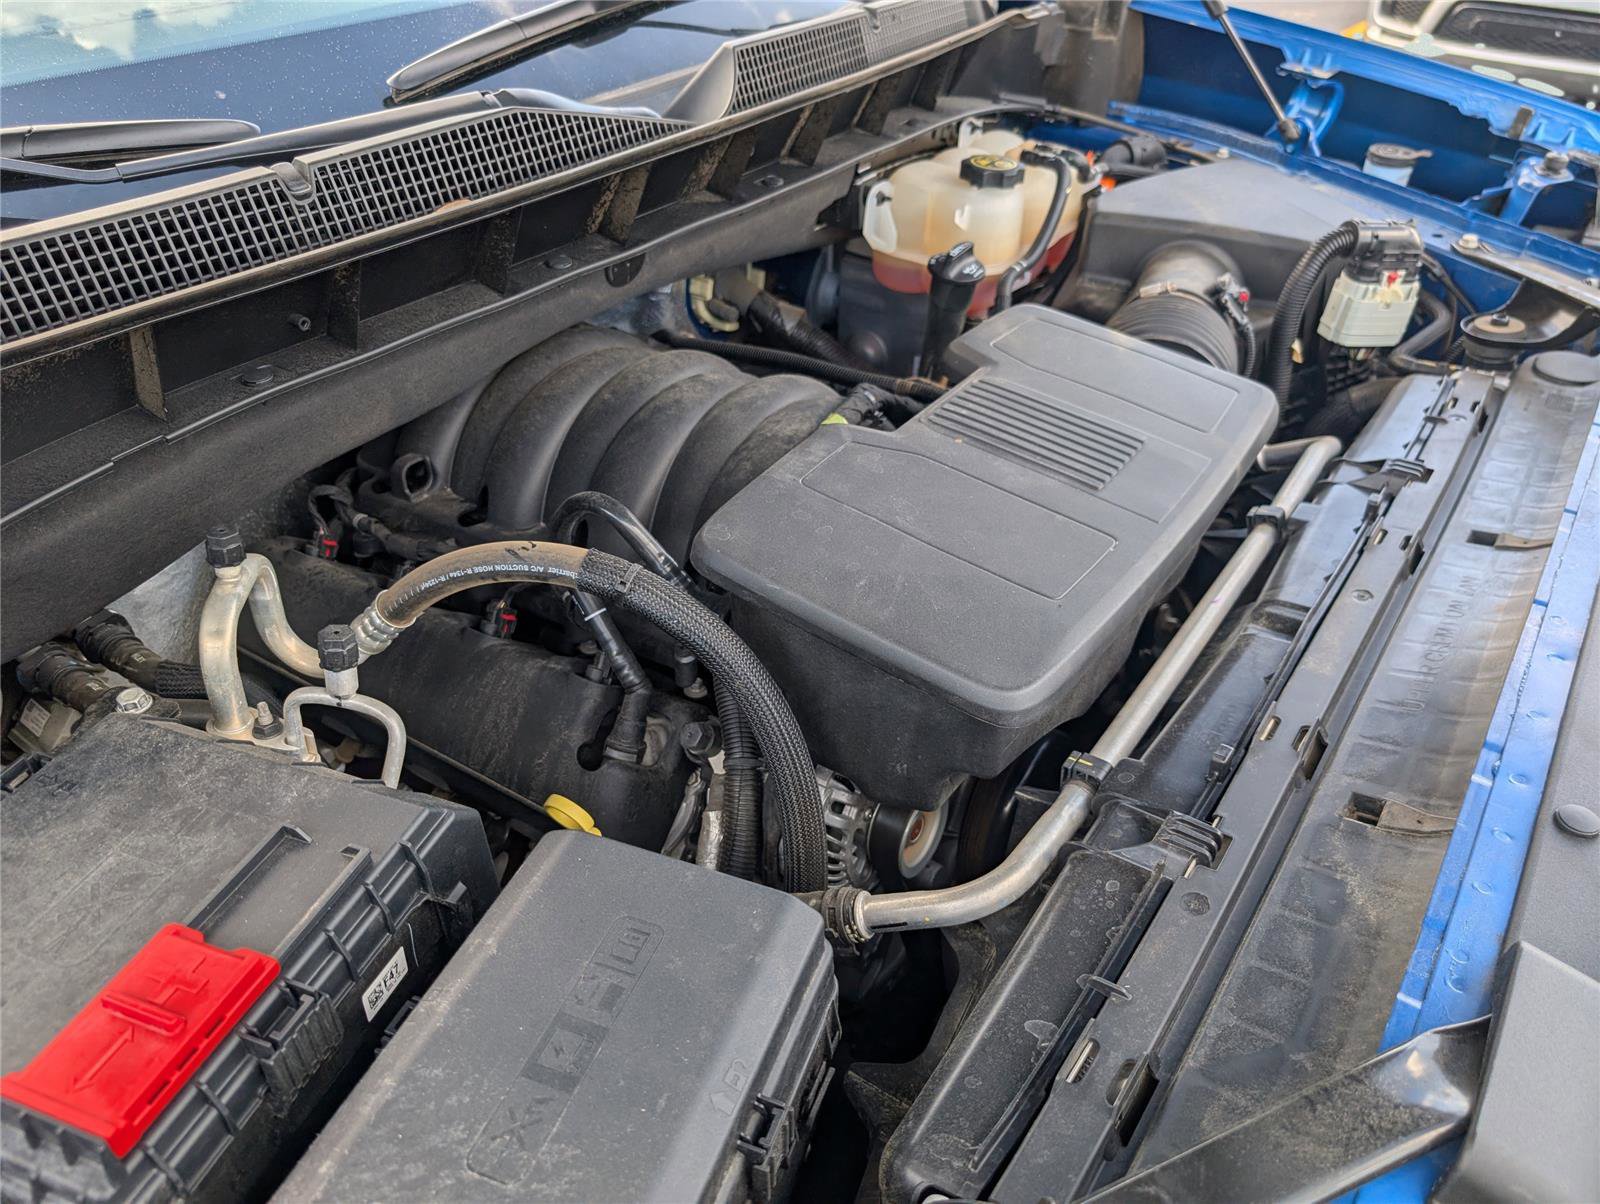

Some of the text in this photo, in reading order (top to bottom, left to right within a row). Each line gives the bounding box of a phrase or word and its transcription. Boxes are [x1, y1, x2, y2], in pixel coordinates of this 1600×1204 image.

[449, 566, 472, 578] R-134a
[471, 564, 494, 573] HOSE
[494, 563, 529, 572] SUCTION
[529, 565, 545, 574] A/C
[383, 961, 399, 988] F47
